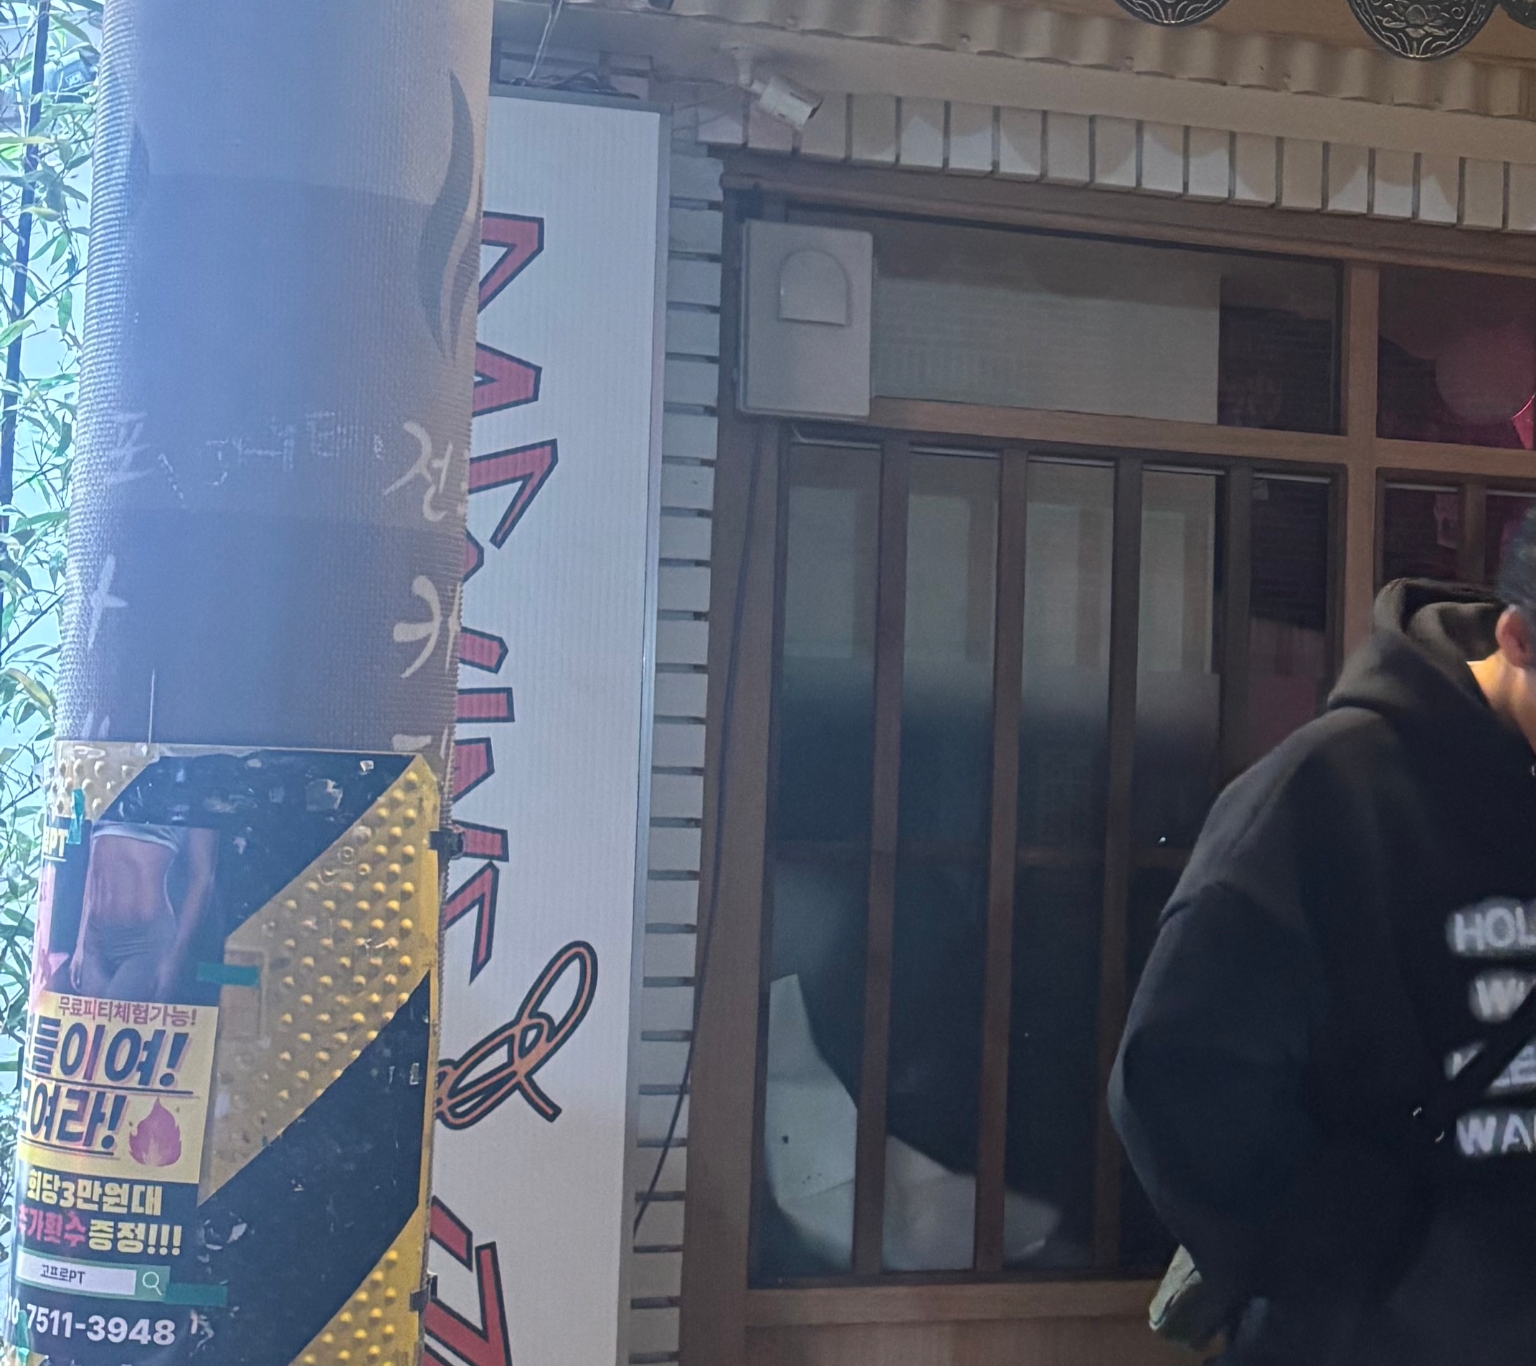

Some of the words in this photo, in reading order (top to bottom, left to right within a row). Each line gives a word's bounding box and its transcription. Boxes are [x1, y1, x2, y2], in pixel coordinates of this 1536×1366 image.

[58, 996, 198, 1027] 무료피티체험가능!
[26, 1013, 190, 1088] 들이여!
[27, 1169, 163, 1216] 회당3만원대
[88, 1218, 183, 1257] 증정!!!
